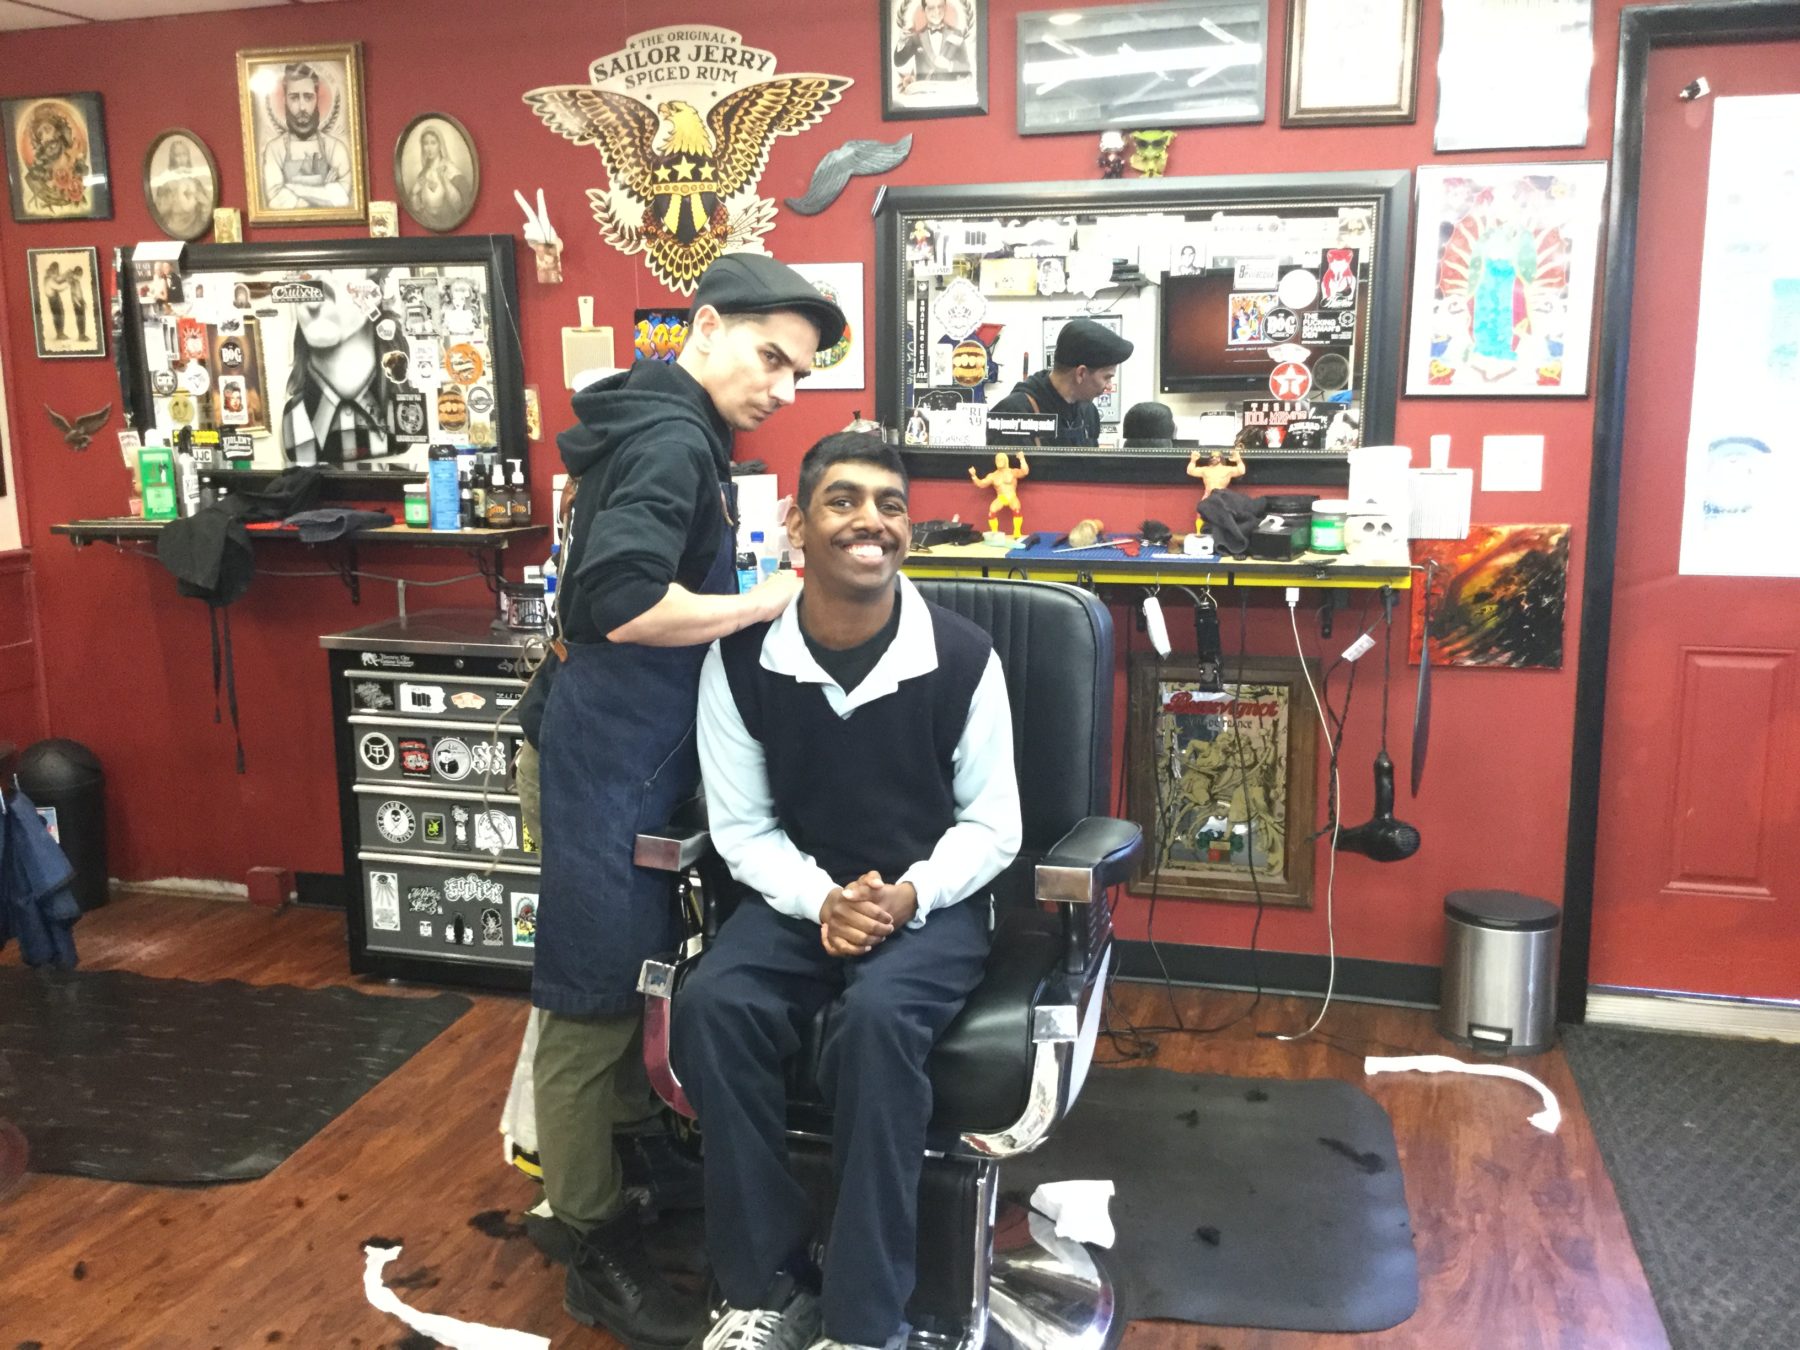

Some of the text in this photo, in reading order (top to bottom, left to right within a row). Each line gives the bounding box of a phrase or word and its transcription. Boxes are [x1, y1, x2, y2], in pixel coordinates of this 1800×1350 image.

[638, 31, 727, 49] THE ORIGINAL
[593, 44, 772, 83] SAILOR JERRY
[624, 66, 738, 90] SPICED RUM
